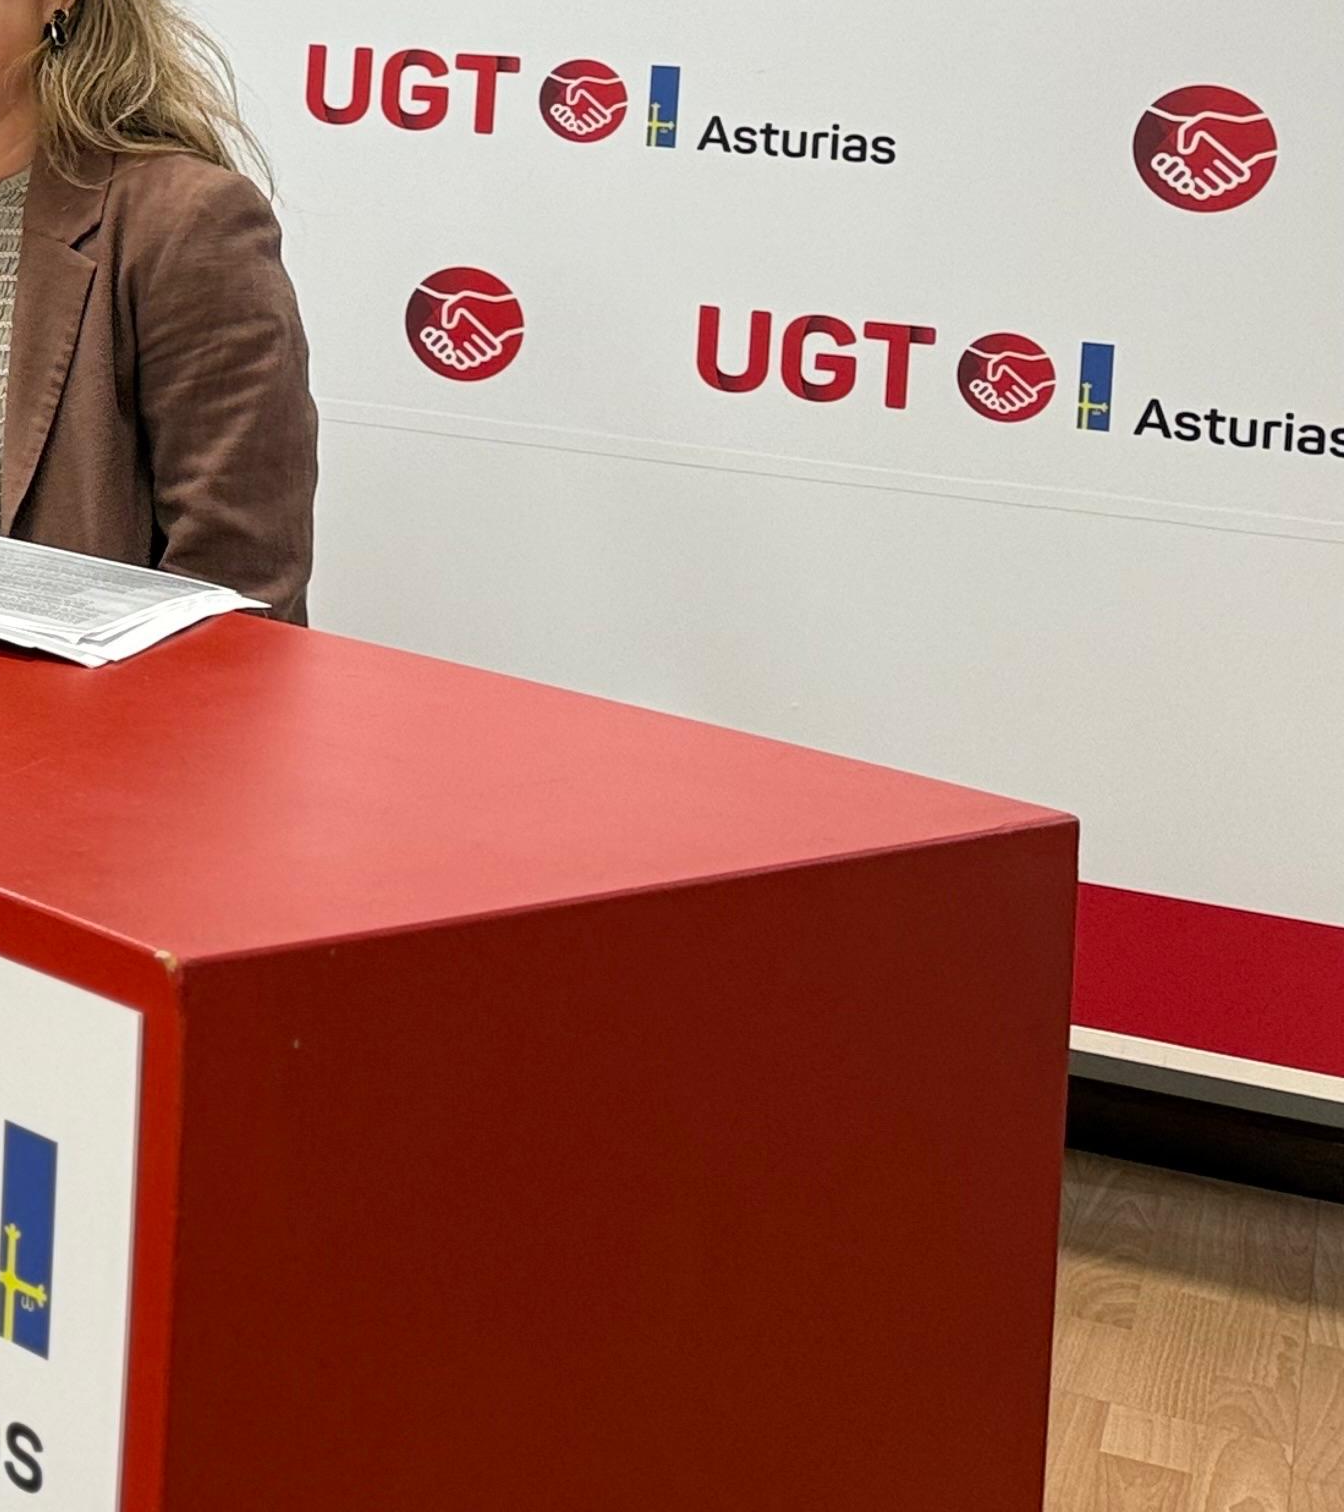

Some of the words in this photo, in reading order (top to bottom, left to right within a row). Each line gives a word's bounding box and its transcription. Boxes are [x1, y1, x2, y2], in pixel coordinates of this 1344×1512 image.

[306, 44, 520, 134] UGT
[697, 116, 895, 164] Asturias
[697, 305, 936, 409] UGT
